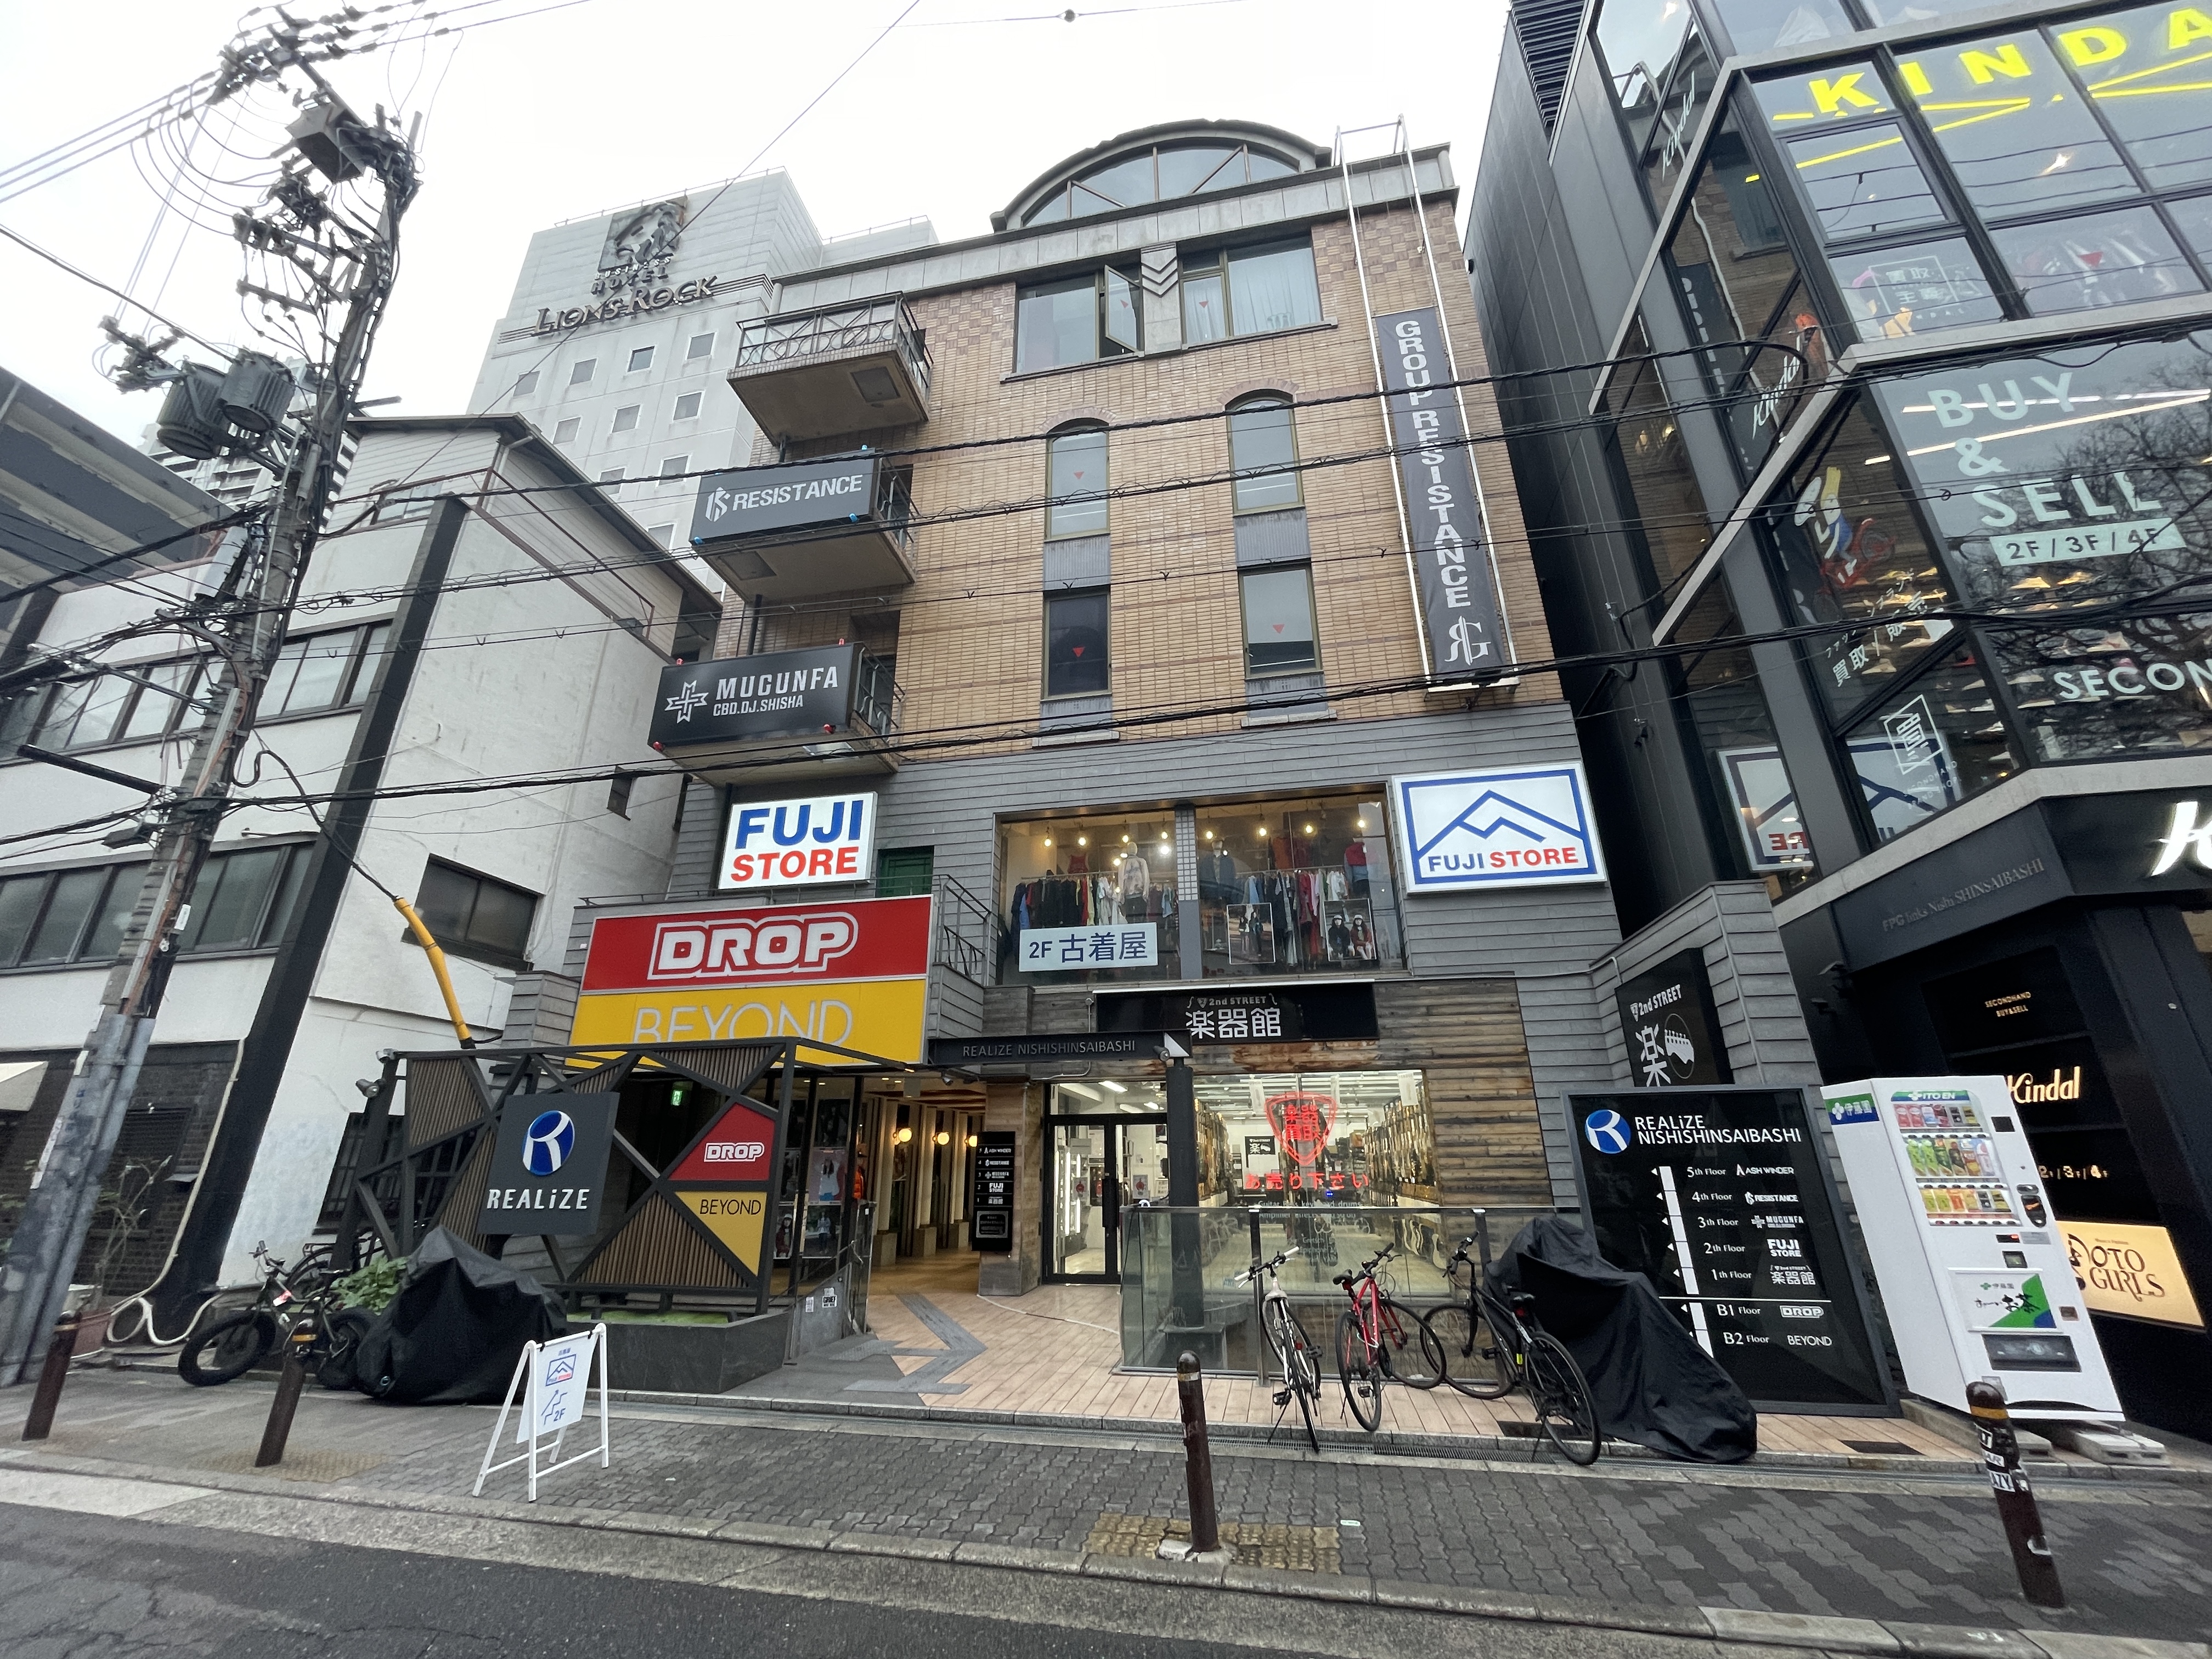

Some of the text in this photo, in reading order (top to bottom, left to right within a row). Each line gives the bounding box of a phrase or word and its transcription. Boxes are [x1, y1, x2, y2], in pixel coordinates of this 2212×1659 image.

[1395, 320, 1431, 406] GROUP
[1927, 371, 2076, 428] BUY
[1955, 437, 2009, 476] &
[732, 475, 863, 511] RESISTANCE
[1972, 470, 2163, 528] SELL
[715, 666, 838, 701] MUGUNFA
[713, 695, 804, 716] CBD.DJ.SHISHA
[736, 800, 864, 849] FUJI
[731, 847, 859, 882] STORE
[1428, 847, 1579, 872] FUJI STORE
[647, 912, 859, 980] DROP
[1029, 931, 1148, 962] 2F 古着屋
[1209, 996, 1266, 1006] 2nd STREET
[1639, 984, 1682, 1015] 2nd STREET
[634, 1000, 853, 1047] BEYOND
[1186, 1007, 1282, 1039] 楽器館
[1018, 1040, 1136, 1055] NISHISHINSAIBASHI
[2006, 1065, 2081, 1104] Kindal
[1638, 1127, 1802, 1145] NISHISHINSAIBASHI
[704, 1142, 765, 1163] DROP
[1245, 1172, 1370, 1190] お売り下さい
[1687, 1166, 1703, 1178] 5th
[699, 1199, 761, 1215] BEYOND
[1692, 1191, 1709, 1203] 4th
[1754, 1194, 1799, 1203] RESISTANCE
[1697, 1216, 1715, 1228] 3th
[1717, 1218, 1739, 1226] Floor
[1703, 1242, 1721, 1254] 2th
[1767, 1239, 1800, 1250] FUJI
[1729, 1271, 1752, 1279] Floor
[1770, 1271, 1816, 1285] 楽器館
[2089, 1266, 2165, 1302] GIRLS
[1717, 1304, 1824, 1319] B1 Floor DROP
[1723, 1331, 1832, 1346] B2 Floor BEYOND
[553, 1407, 566, 1422] 2F
